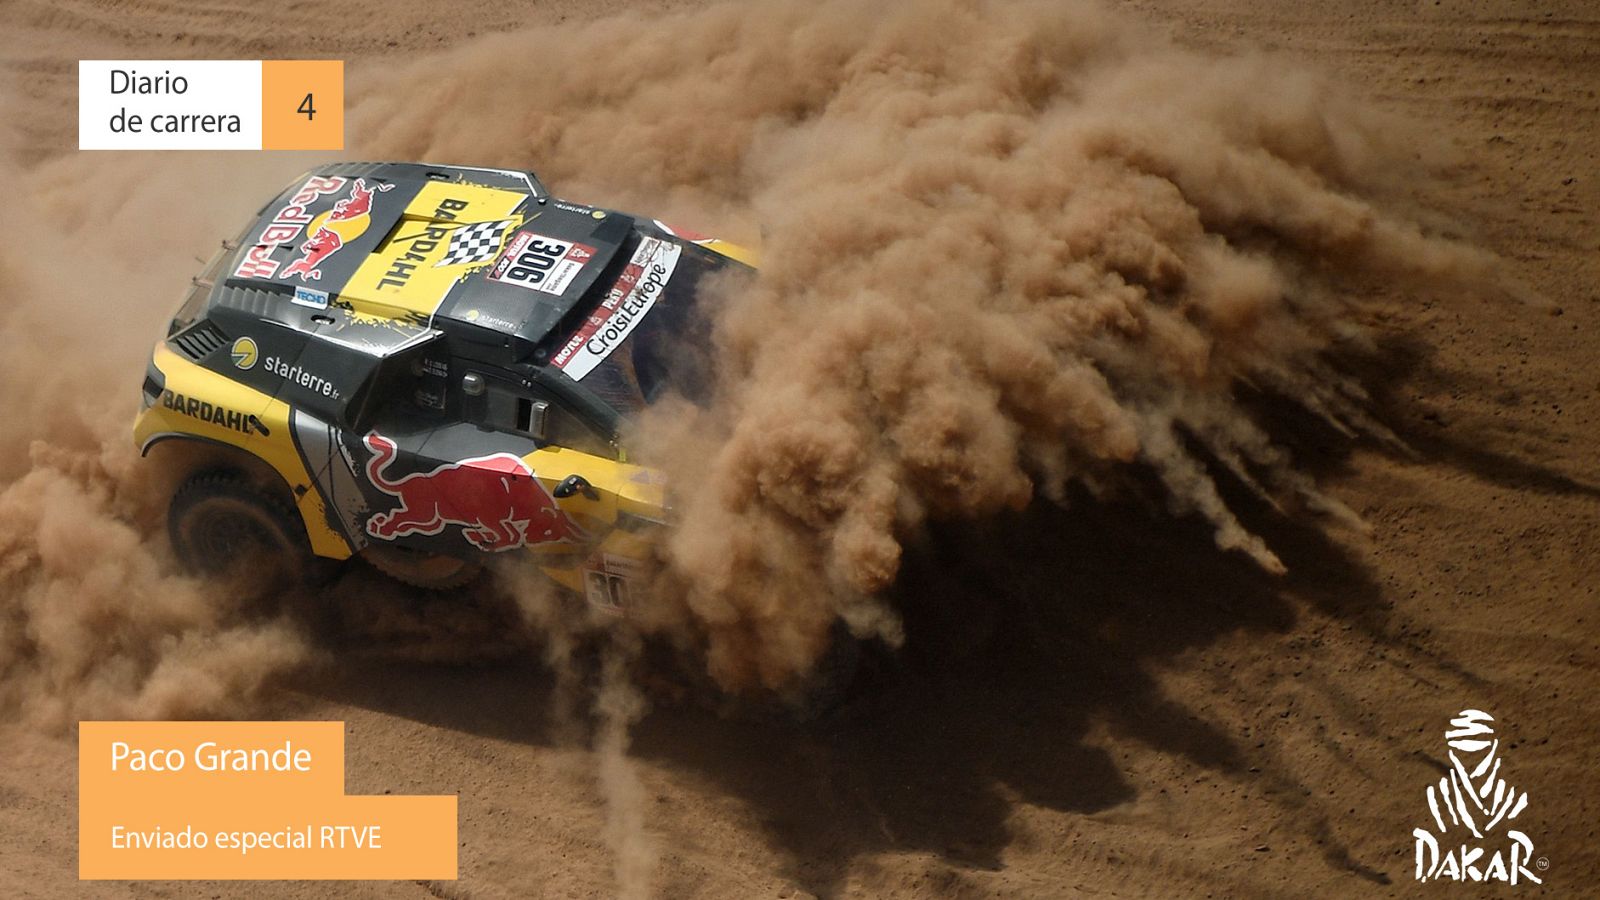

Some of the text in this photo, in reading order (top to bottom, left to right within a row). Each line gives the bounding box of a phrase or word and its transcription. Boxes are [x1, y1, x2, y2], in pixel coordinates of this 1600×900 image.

[234, 176, 348, 280] Red Bull
[376, 198, 469, 291] BARDAHL
[507, 240, 566, 284] 306
[586, 263, 667, 355] CroisiEurope
[554, 335, 585, 365] MOTUL
[264, 356, 340, 400] starterre.fr
[163, 388, 252, 434] BARDAHL
